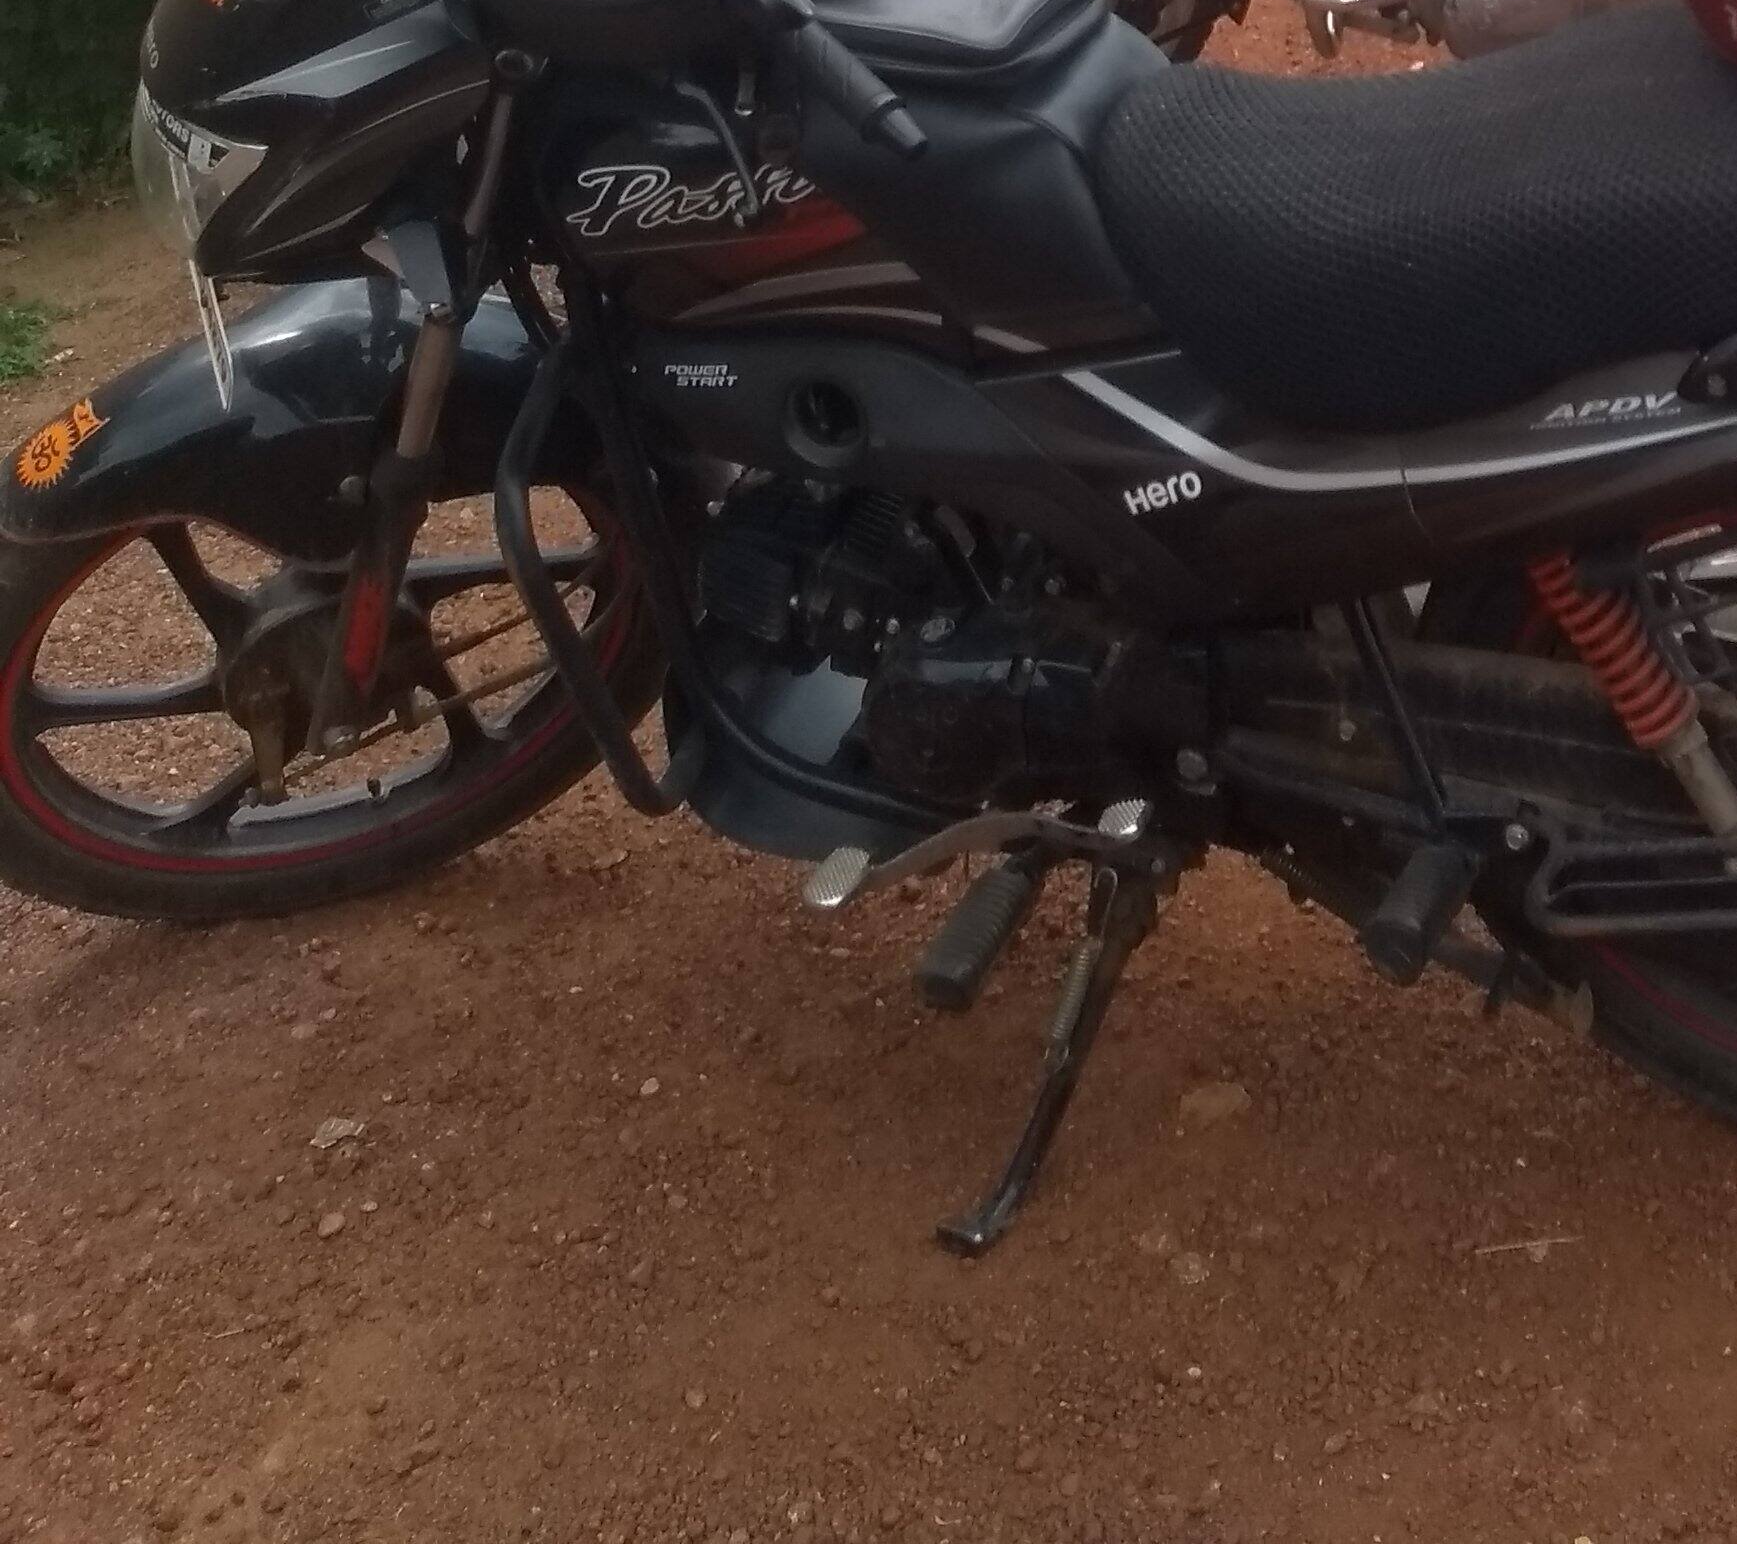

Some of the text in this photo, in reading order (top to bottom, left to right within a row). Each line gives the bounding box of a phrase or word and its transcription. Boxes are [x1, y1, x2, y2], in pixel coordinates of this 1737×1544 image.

[664, 364, 728, 375] POWER
[676, 375, 739, 386] START
[1123, 471, 1202, 515] Hero
